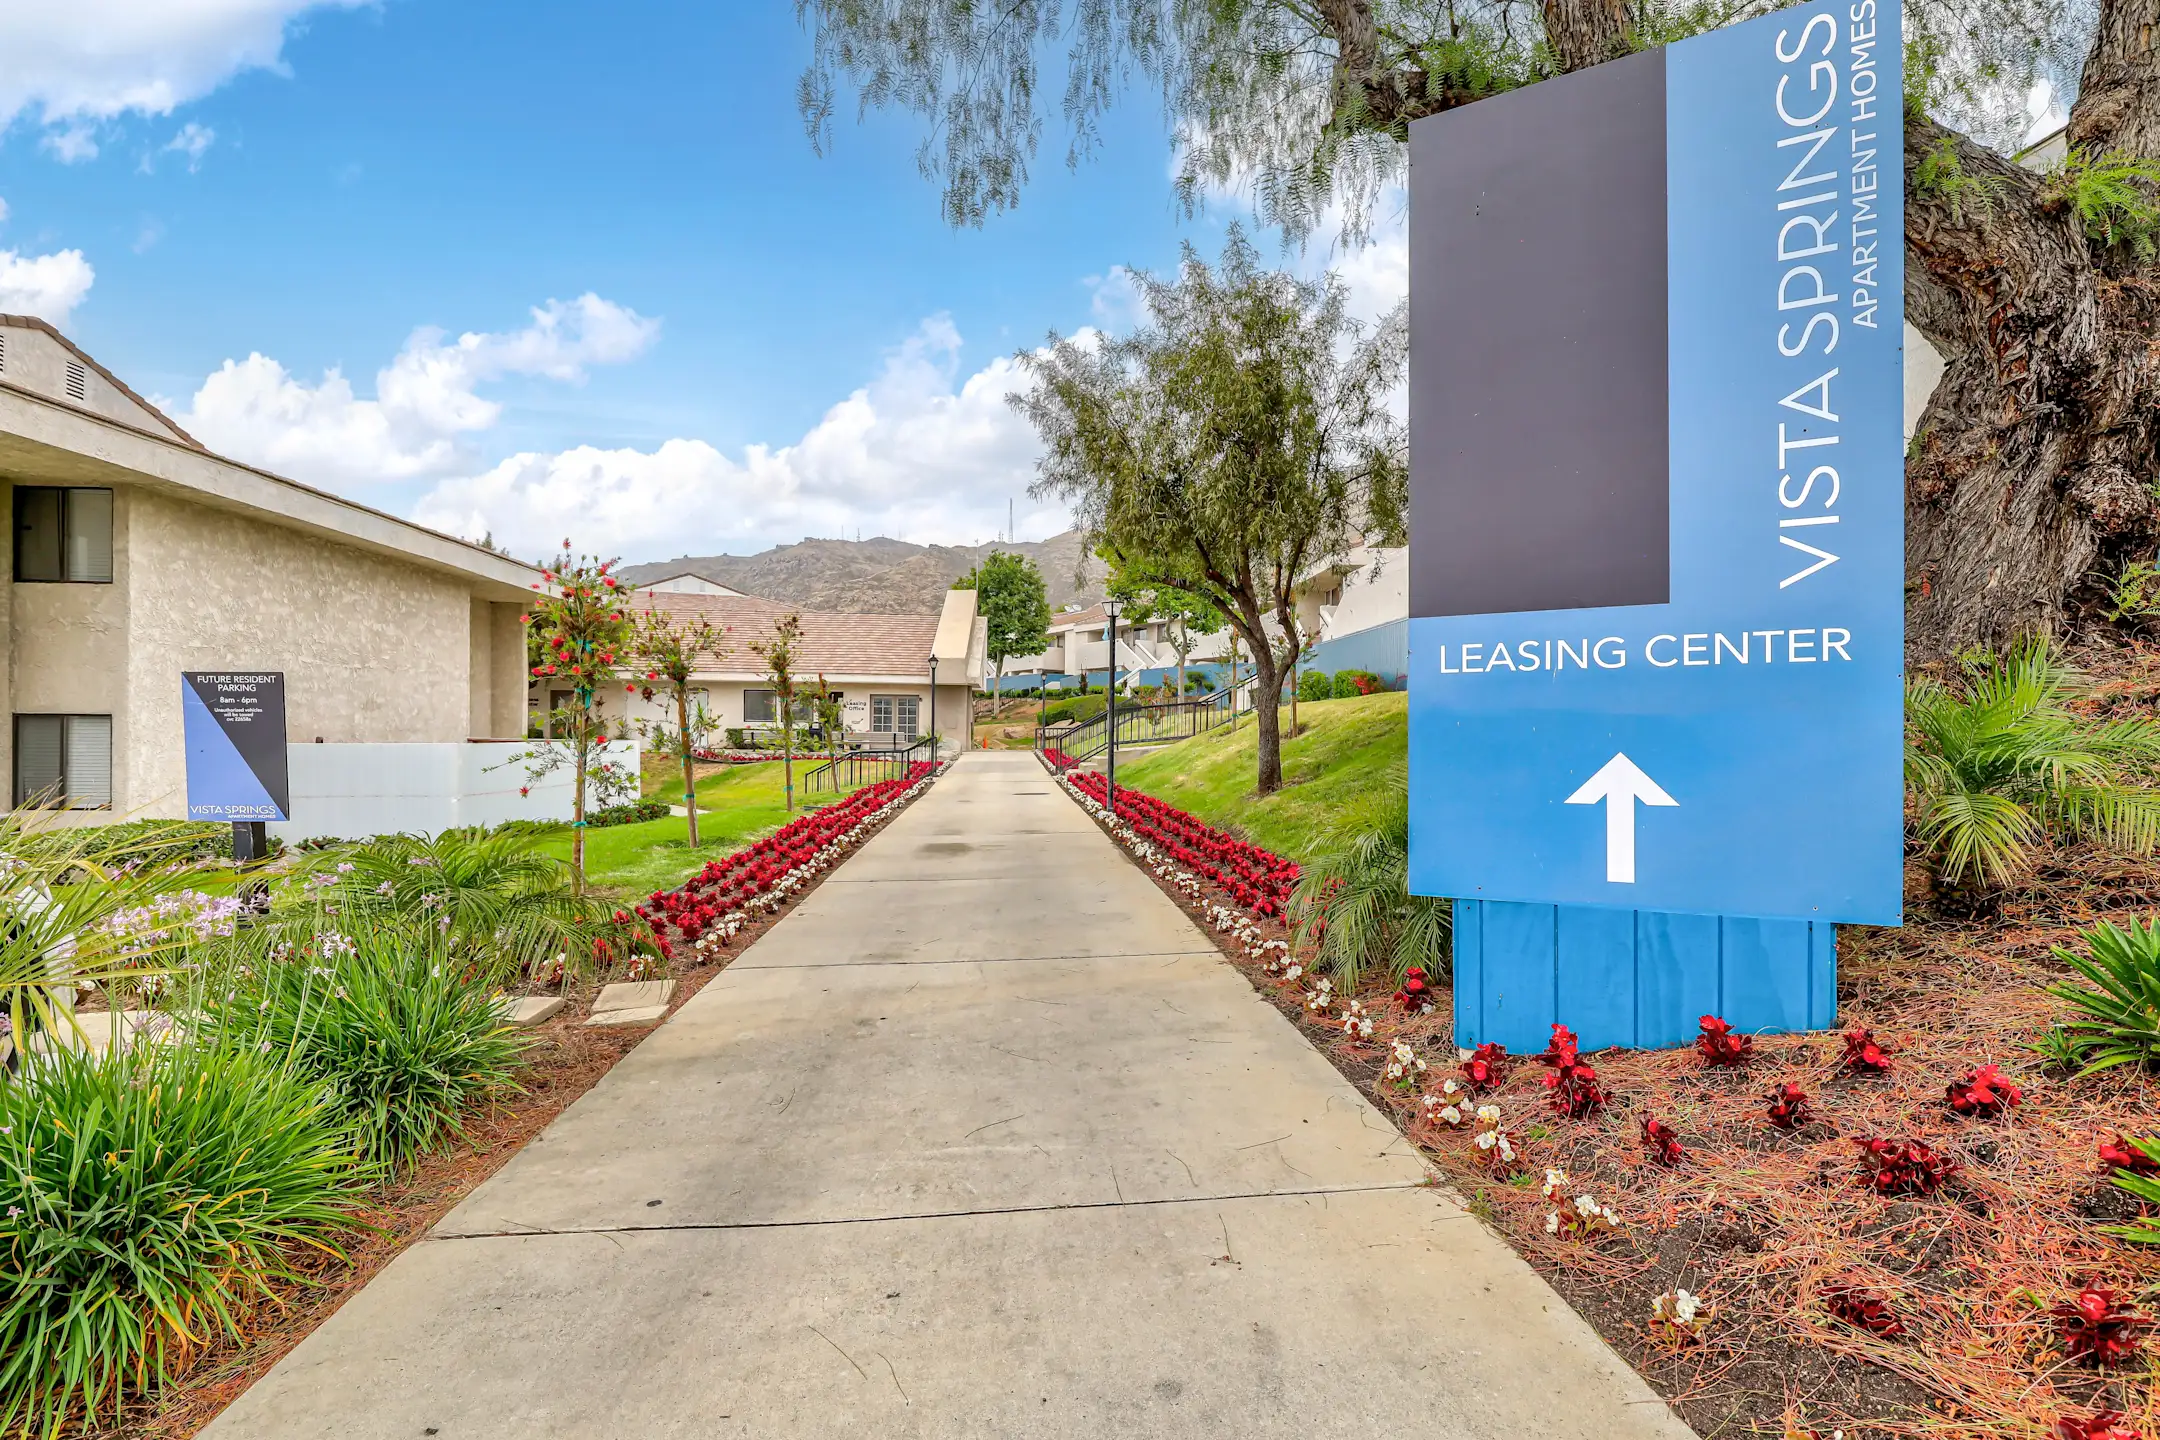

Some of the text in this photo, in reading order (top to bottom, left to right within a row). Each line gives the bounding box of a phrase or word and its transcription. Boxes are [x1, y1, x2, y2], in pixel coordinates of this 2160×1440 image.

[1850, 0, 1879, 329] APARTMENT HOMES
[1775, 13, 1841, 590] VISTA SPRINGS
[1439, 627, 1853, 674] LEASING CENTER
[197, 675, 276, 683] FUTURE RESIDENT
[217, 684, 257, 692] PARKING
[219, 696, 235, 704] 8am
[241, 696, 258, 704] 6pm
[190, 805, 276, 814] VISTA SPRINGS
